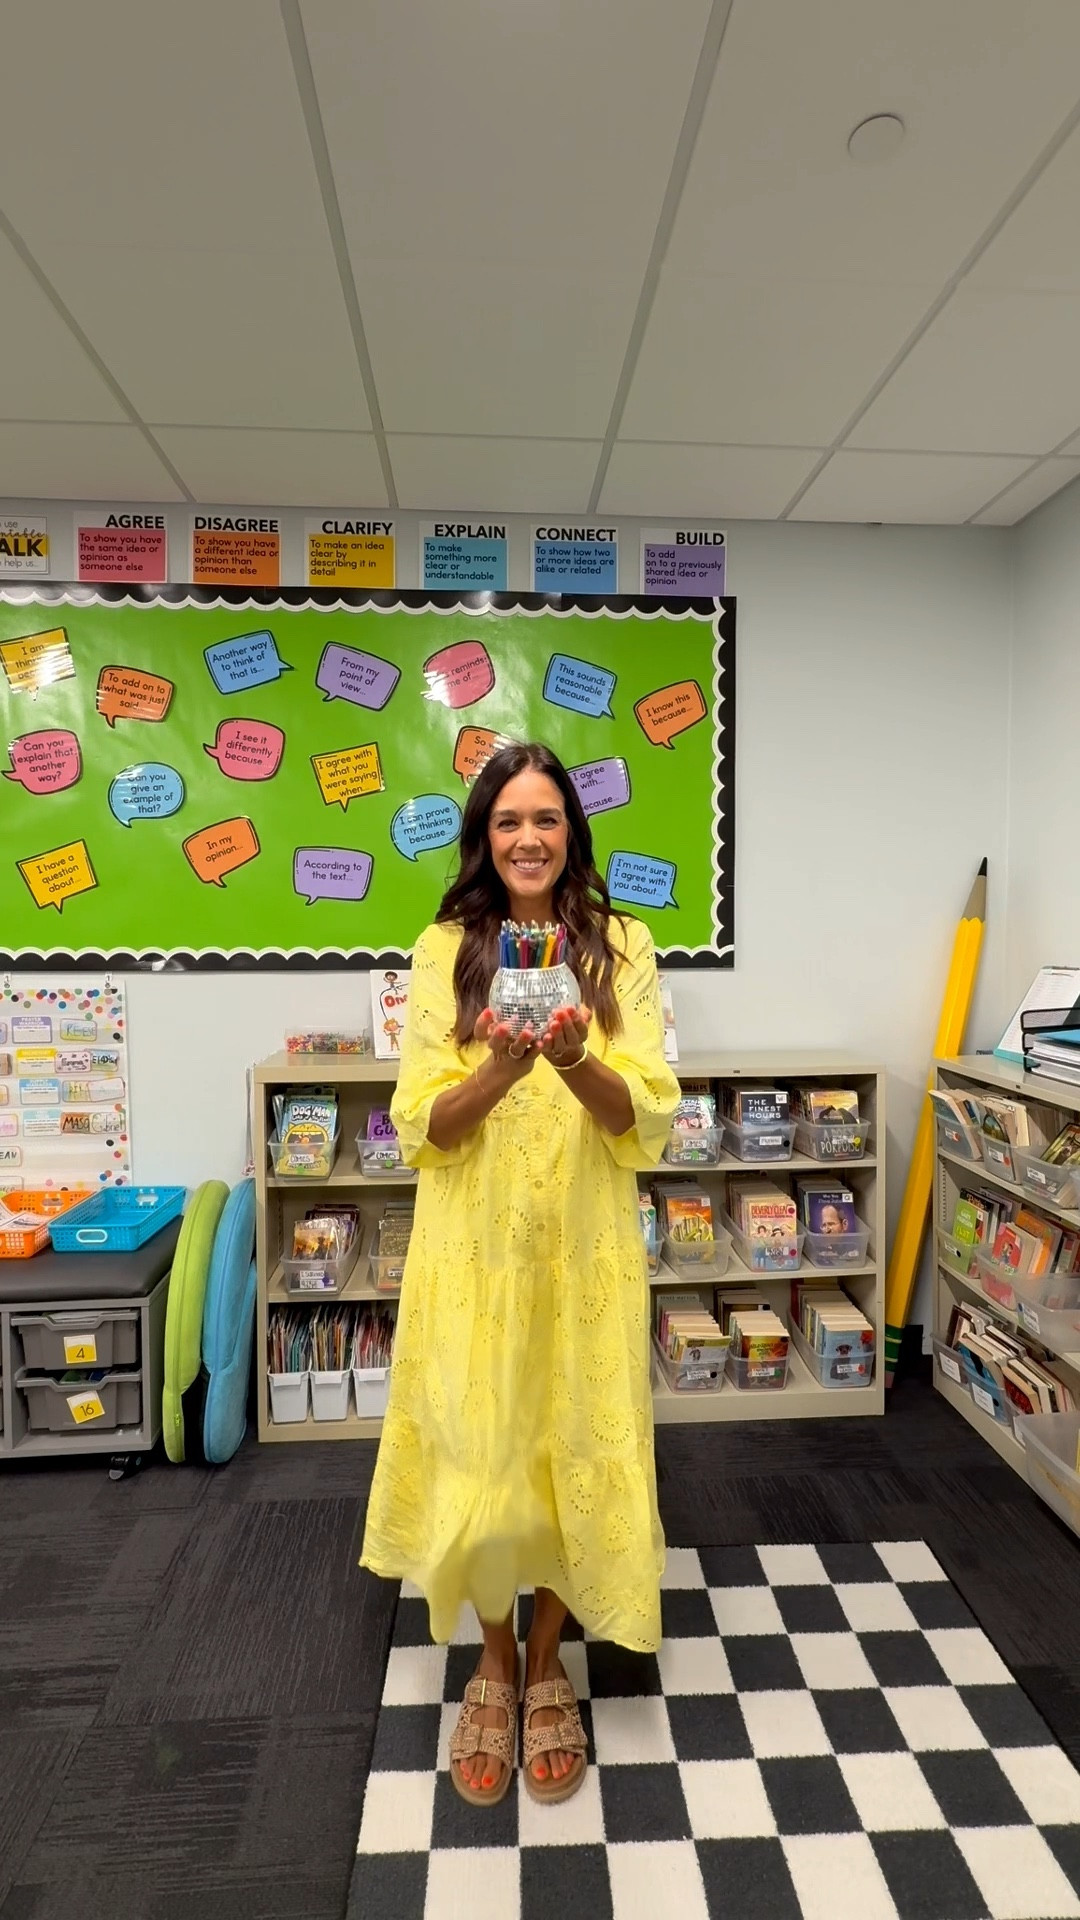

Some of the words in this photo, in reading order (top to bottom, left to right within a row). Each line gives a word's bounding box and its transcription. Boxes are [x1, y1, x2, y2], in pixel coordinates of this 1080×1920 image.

[105, 514, 165, 529] AGREE
[194, 516, 279, 533] DISAGREE
[321, 520, 393, 536] CLARIFY
[434, 524, 506, 539] EXPLAIN
[535, 527, 616, 542] CONNECT
[676, 531, 724, 546] BUILD
[80, 533, 90, 542] To
[93, 534, 117, 543] show
[120, 537, 136, 545] you
[139, 536, 162, 544] have
[310, 539, 320, 548] To
[324, 541, 348, 549] make
[365, 541, 385, 550] idea
[0, 538, 43, 557] ALK
[204, 546, 243, 555] different
[246, 547, 266, 557] idea
[425, 543, 435, 551] To
[438, 544, 462, 552] make
[536, 546, 546, 555] To
[549, 547, 570, 556] show
[573, 548, 591, 556] how
[594, 549, 610, 557] two
[646, 549, 655, 558] To
[658, 550, 675, 559] add
[80, 553, 114, 562] opinion
[194, 556, 228, 565] opinion
[232, 557, 252, 565] than
[425, 553, 471, 564] something
[80, 562, 122, 571] someone
[126, 562, 143, 571] else
[310, 568, 336, 576] detail
[425, 571, 494, 580] understandable
[645, 577, 676, 586] opinion
[21, 646, 27, 656] I
[212, 647, 248, 663] Another
[249, 641, 268, 652] way
[221, 662, 231, 671] to
[232, 655, 255, 668] think
[256, 650, 265, 660] of
[341, 656, 364, 672] From
[366, 667, 380, 678] my
[450, 656, 485, 676] reminds
[230, 668, 248, 680] that
[340, 670, 363, 682] point
[364, 677, 374, 686] of
[559, 662, 575, 676] This
[576, 672, 606, 686] sounds
[108, 672, 119, 683] To
[122, 678, 141, 688] add
[142, 683, 154, 691] on
[157, 685, 165, 694] to
[555, 675, 602, 696] reasonable
[104, 685, 127, 696] what
[129, 691, 146, 701] was
[148, 694, 166, 705] just
[646, 708, 652, 718] I
[652, 701, 674, 715] know
[675, 693, 691, 704] this
[235, 730, 241, 740] I
[243, 734, 258, 743] see
[260, 736, 267, 744] it
[474, 735, 487, 747] So
[23, 742, 44, 751] Can
[46, 740, 64, 750] you
[226, 740, 273, 759] differently
[17, 752, 52, 764] explain
[54, 747, 73, 758] that
[317, 761, 324, 770] I
[325, 756, 352, 769] agree
[353, 749, 373, 761] with
[29, 761, 66, 773] another
[327, 766, 350, 779] what
[352, 762, 368, 774] you
[573, 772, 579, 781] I
[580, 766, 606, 780] agree
[37, 771, 62, 782] way?
[149, 773, 166, 783] you
[325, 779, 347, 790] were
[349, 771, 378, 784] saying
[130, 785, 150, 796] give
[339, 786, 363, 798] when
[123, 794, 162, 804] example
[164, 792, 174, 801] of
[583, 796, 620, 811] ecause...
[138, 804, 161, 814] that?
[399, 816, 405, 825] I
[407, 814, 424, 824] can
[425, 806, 451, 821] prove
[403, 826, 417, 836] my
[419, 817, 454, 831] thinking
[206, 841, 218, 851] In
[219, 835, 233, 845] my
[36, 865, 43, 874] I
[43, 858, 67, 872] have
[303, 859, 351, 873] According
[353, 863, 363, 871] to
[617, 858, 632, 868] I'm
[633, 864, 649, 873] not
[649, 868, 669, 877] sure
[41, 865, 79, 885] question
[312, 871, 327, 880] the
[615, 868, 621, 877] I
[620, 872, 648, 883] agree
[648, 878, 668, 887] with
[614, 881, 630, 890] you
[291, 1103, 312, 1116] DOG
[373, 1125, 398, 1137] GU
[76, 1347, 85, 1359] 4
[80, 1404, 95, 1417] 16
